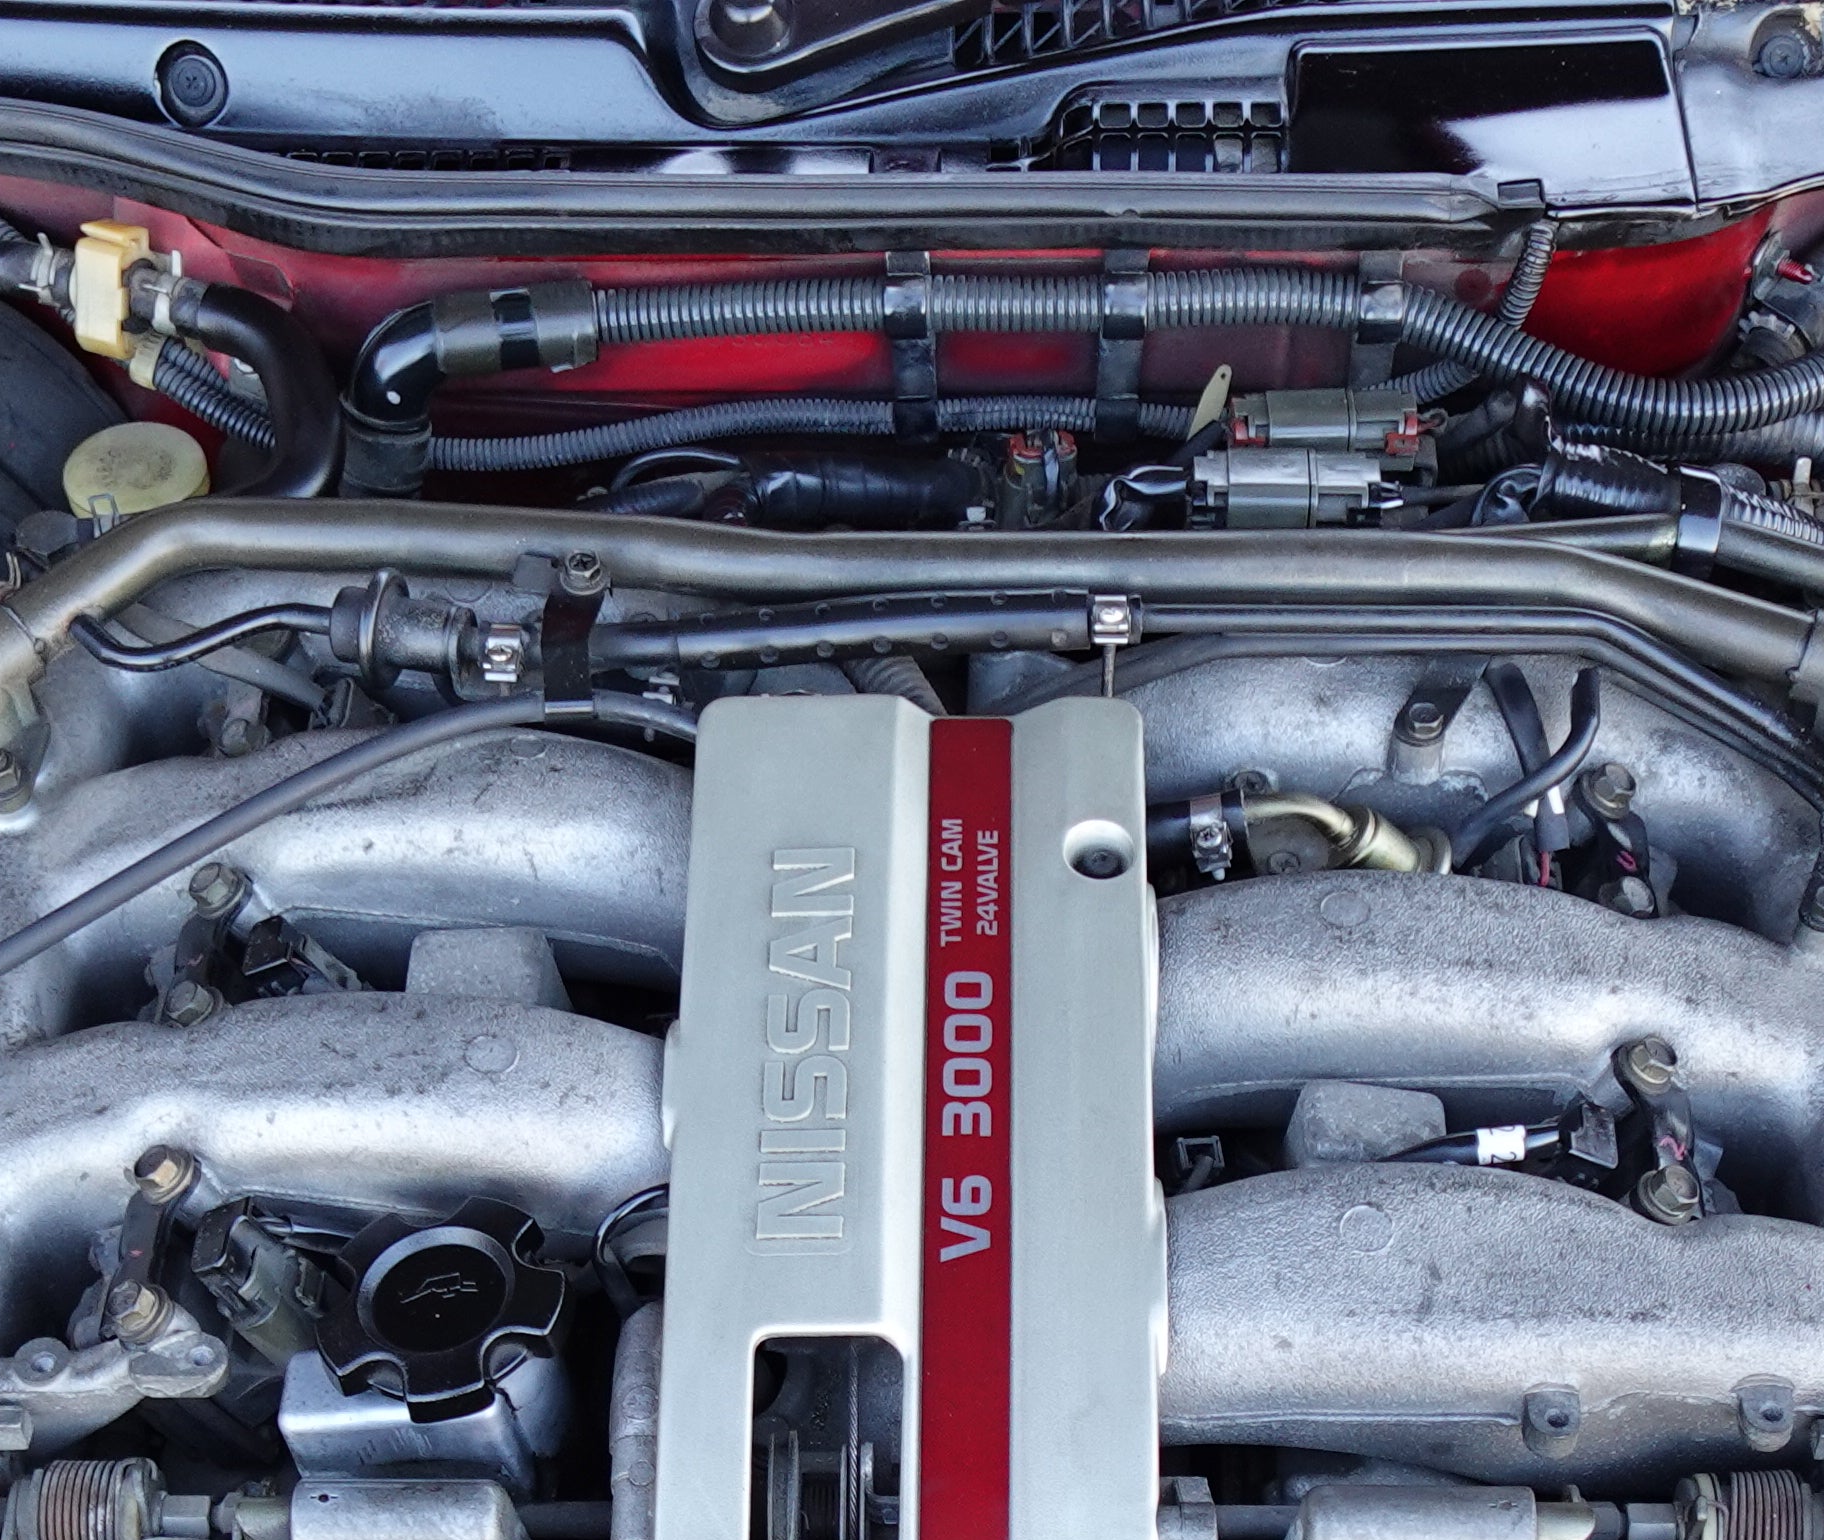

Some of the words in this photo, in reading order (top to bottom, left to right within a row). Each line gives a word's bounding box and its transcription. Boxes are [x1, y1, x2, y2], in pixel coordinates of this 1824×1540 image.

[941, 817, 966, 870] CAM
[976, 828, 999, 938] 24VALVE
[939, 876, 966, 948] TWIN
[756, 846, 856, 1242] NISSAN
[941, 969, 995, 1139] 3000
[939, 1177, 993, 1264] V6
